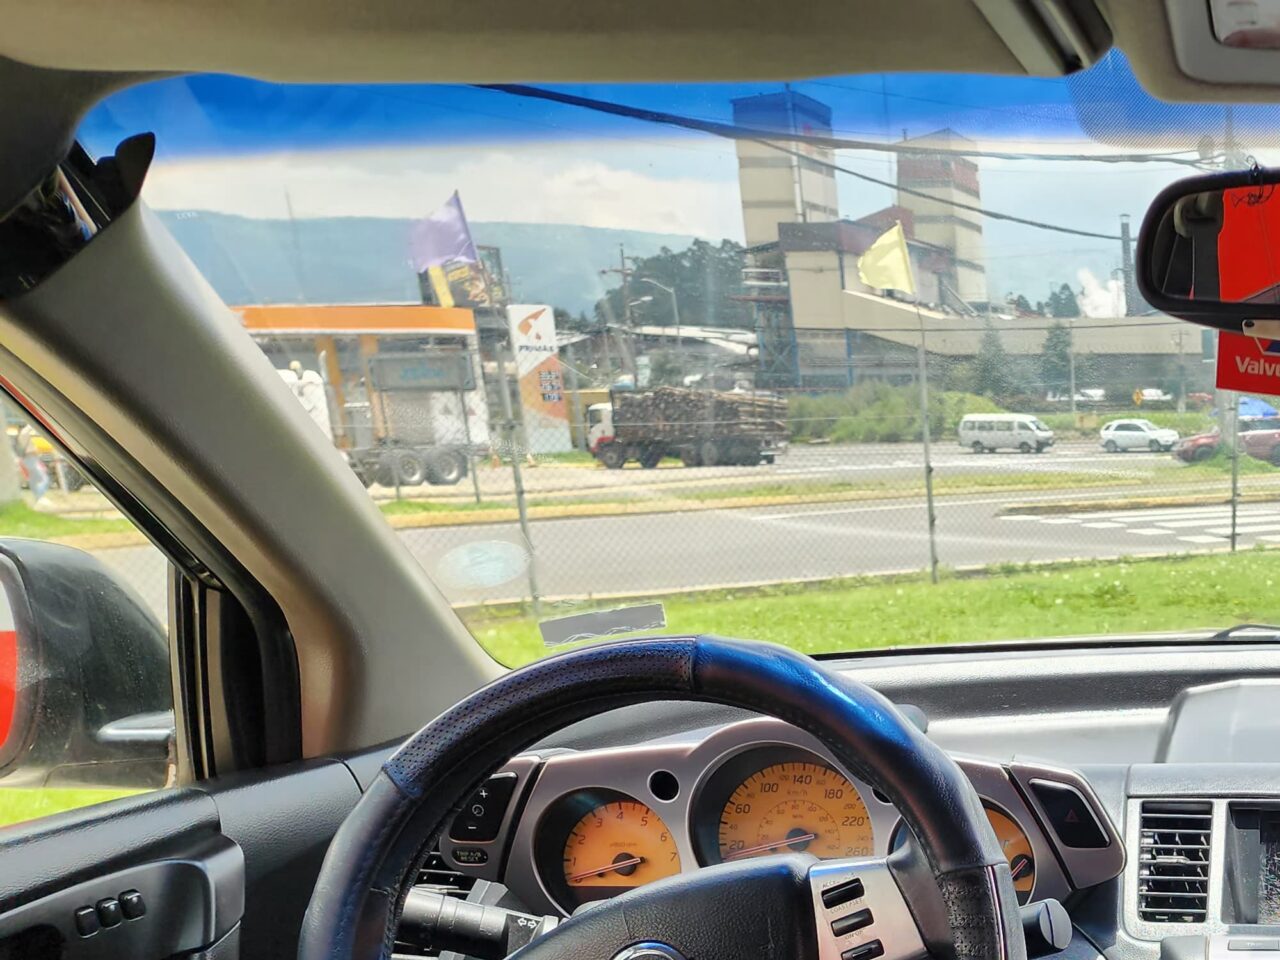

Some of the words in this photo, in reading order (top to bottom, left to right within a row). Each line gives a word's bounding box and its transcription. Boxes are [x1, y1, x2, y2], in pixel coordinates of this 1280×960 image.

[791, 774, 813, 785] 140
[759, 782, 779, 794] 100
[823, 788, 844, 800] 180
[735, 803, 751, 815] 60
[616, 811, 625, 821] 4
[640, 815, 649, 827] 5
[841, 815, 865, 827] 220
[595, 817, 603, 828] 3
[578, 834, 586, 845] 2
[660, 832, 669, 842] 6
[728, 839, 745, 851] 20
[669, 851, 678, 863] 7
[844, 846, 869, 858] 260
